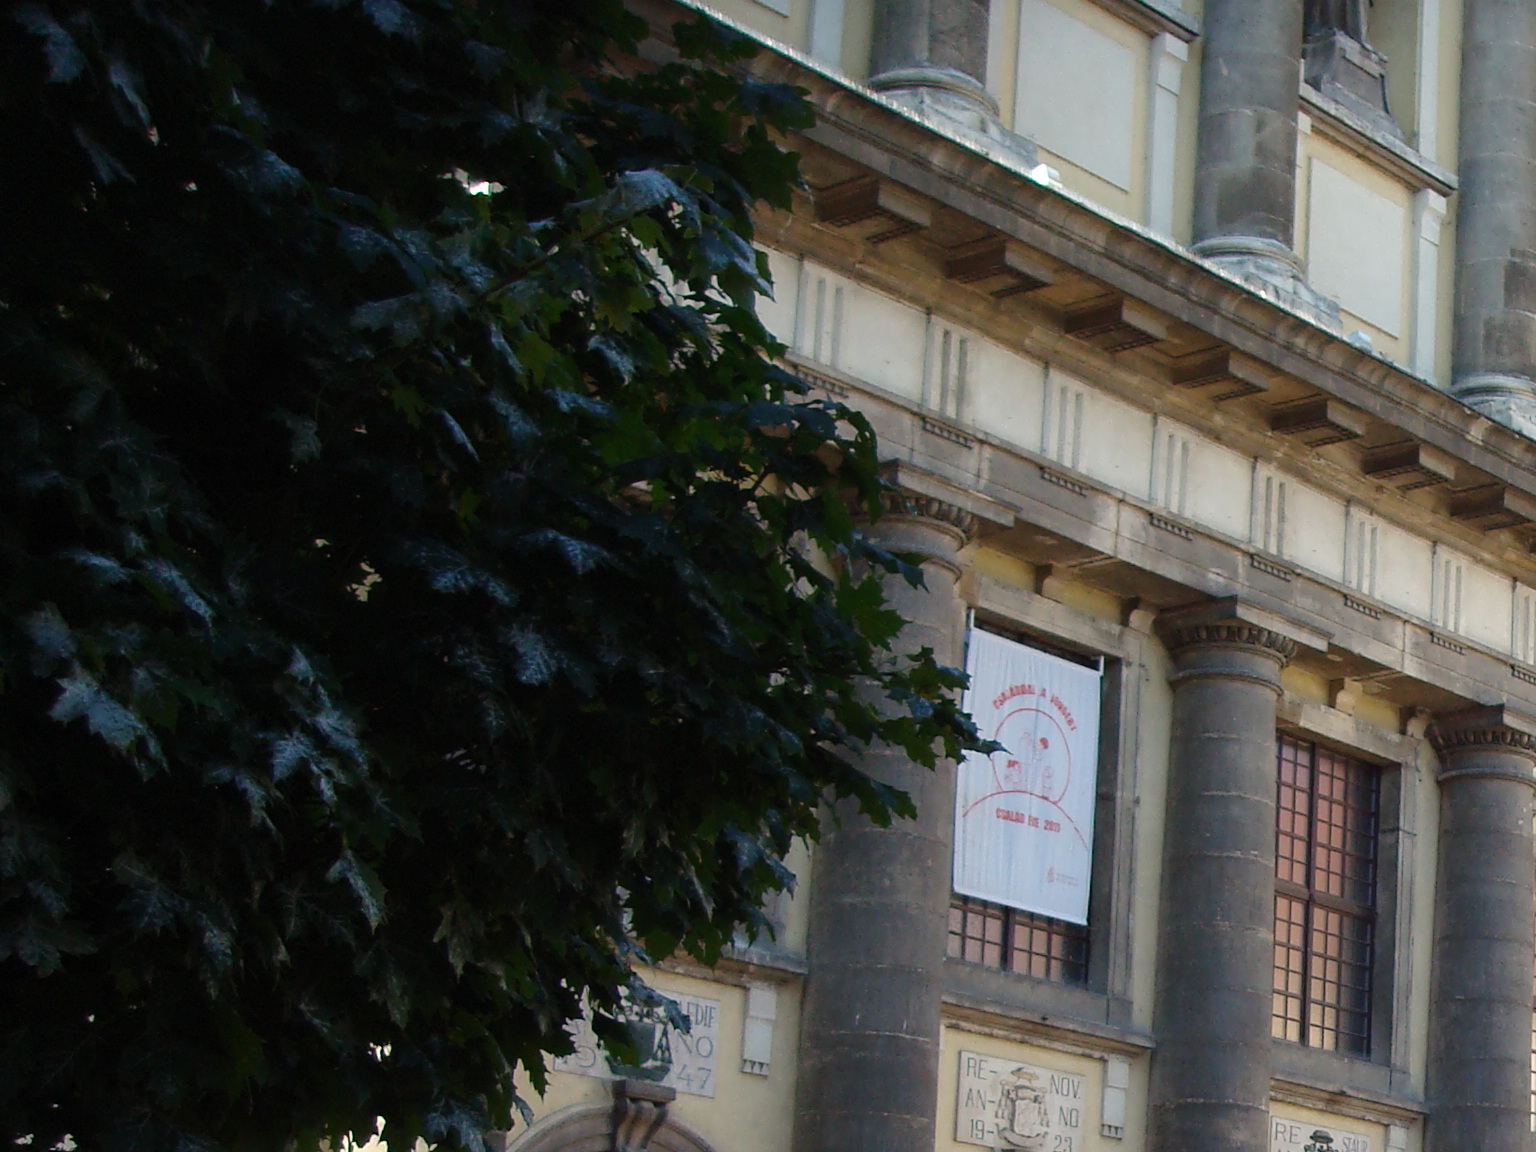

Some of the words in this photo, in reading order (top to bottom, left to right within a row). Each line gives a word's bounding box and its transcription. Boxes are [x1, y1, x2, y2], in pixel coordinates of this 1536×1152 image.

[677, 1064, 712, 1090] 47
[1050, 1074, 1081, 1100] NOV.
[1058, 1105, 1079, 1129] NO
[1275, 1122, 1301, 1145] RE
